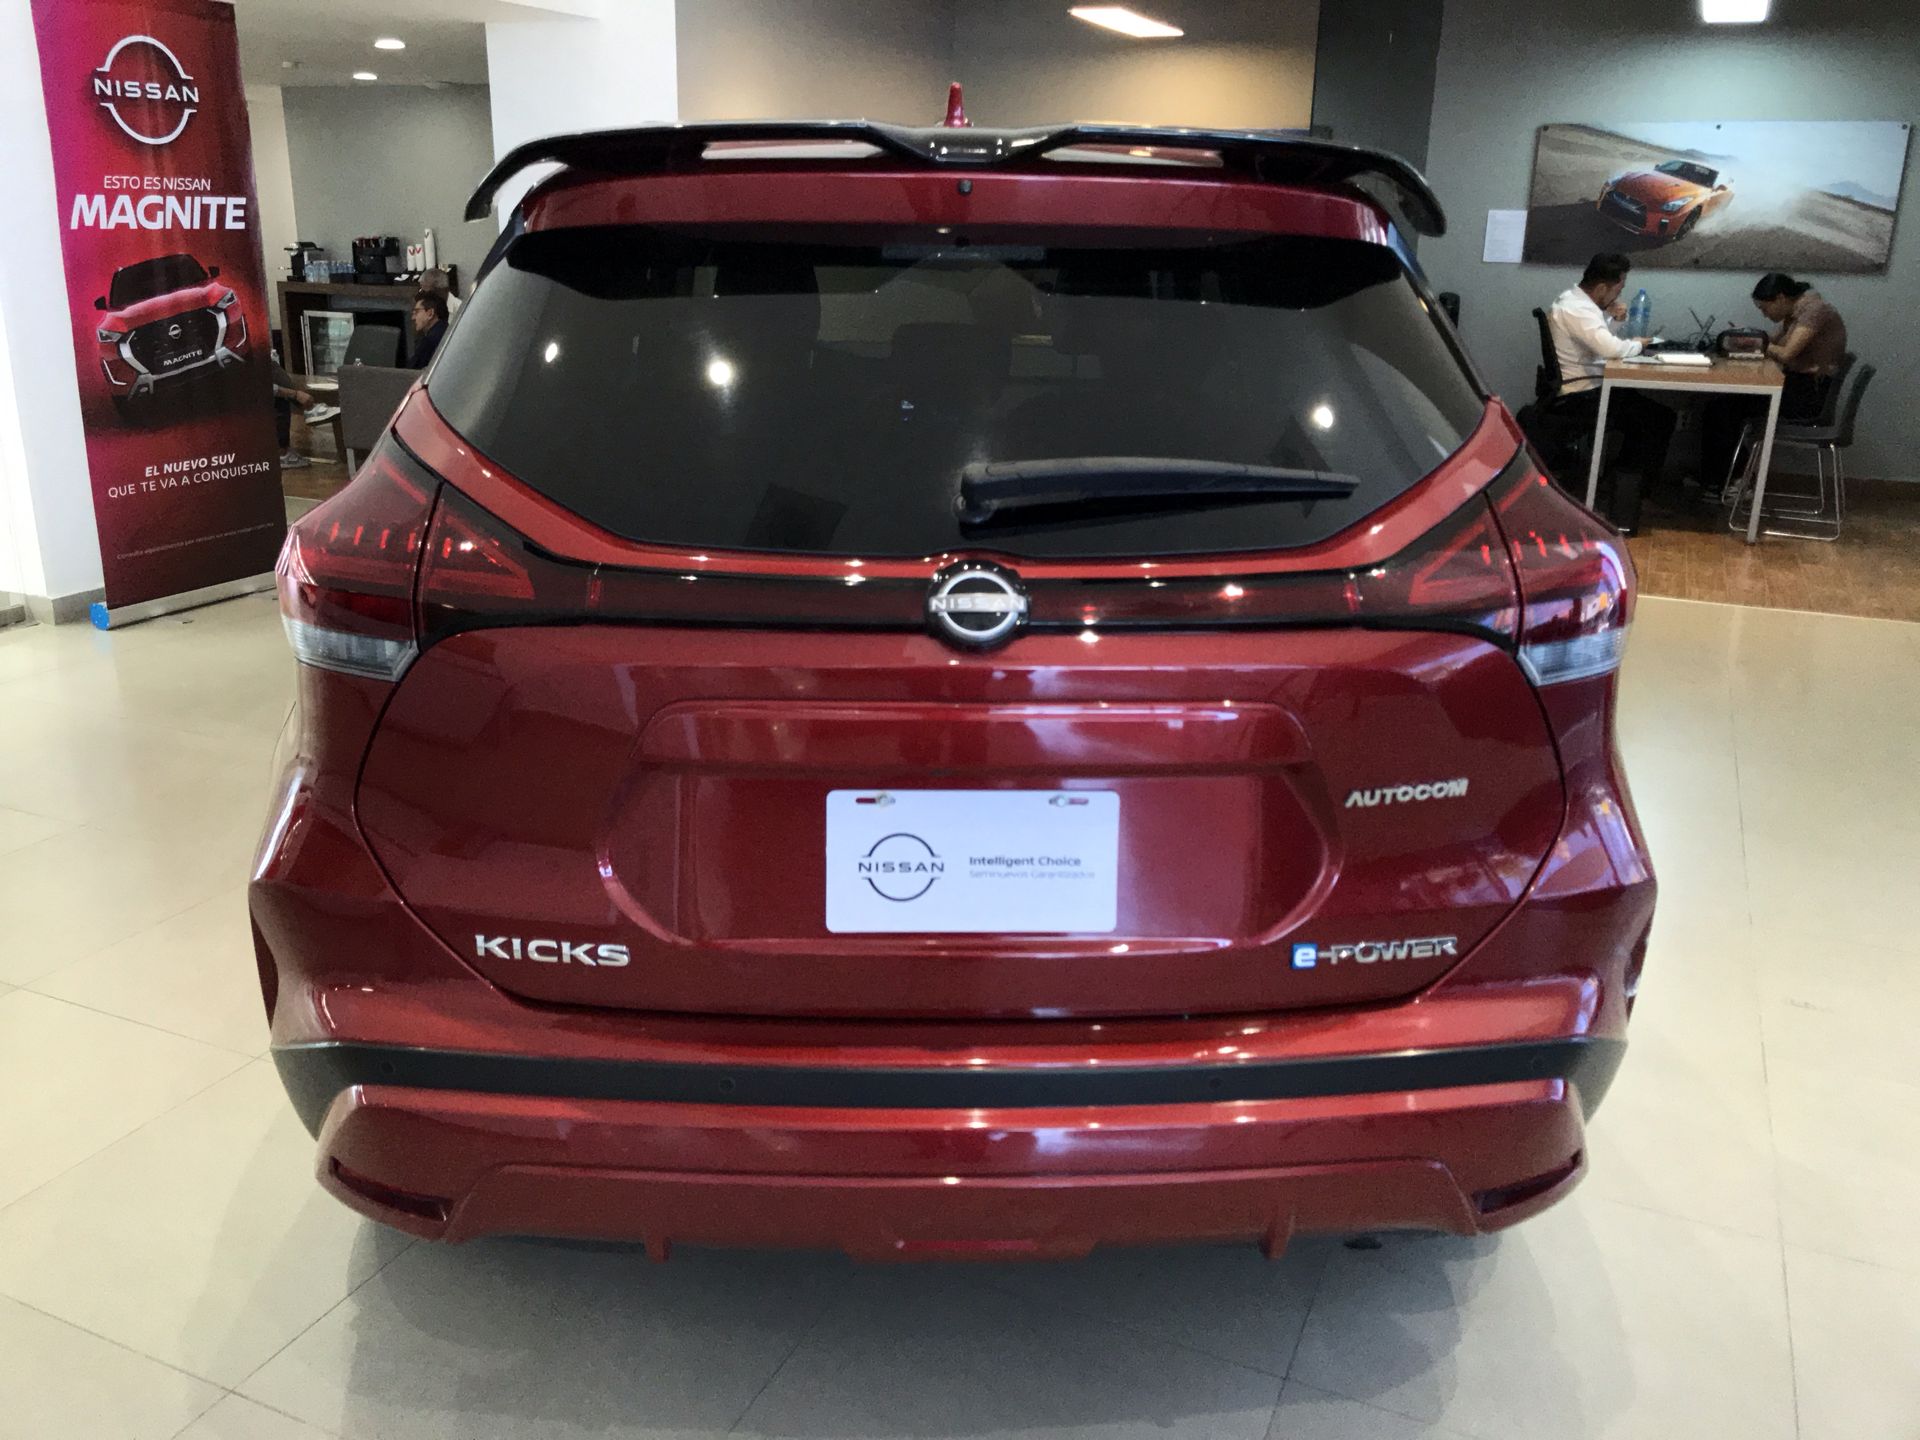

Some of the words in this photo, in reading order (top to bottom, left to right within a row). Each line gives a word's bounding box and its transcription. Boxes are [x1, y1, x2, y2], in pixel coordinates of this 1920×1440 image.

[94, 78, 199, 102] NISSAN
[104, 176, 140, 189] ESTO
[143, 176, 161, 190] ES
[163, 177, 211, 191] NISSAN
[70, 194, 247, 230] MAGNITE
[163, 349, 203, 366] MAGNITE
[145, 465, 160, 477] EL
[163, 457, 208, 474] NUEVO
[211, 453, 236, 467] SUV
[108, 483, 136, 498] QUE
[140, 480, 157, 493] TE
[159, 478, 178, 490] VA
[181, 475, 191, 486] A
[193, 461, 270, 484] CONQUISTAR
[931, 597, 1025, 612] NISSAN
[1345, 777, 1469, 808] AUTOCOM
[858, 861, 945, 873] NISSAN
[969, 856, 1035, 868] Intelligent
[1038, 856, 1081, 867] Choice
[475, 934, 630, 967] KICKS
[1293, 936, 1458, 967] e-POWER
